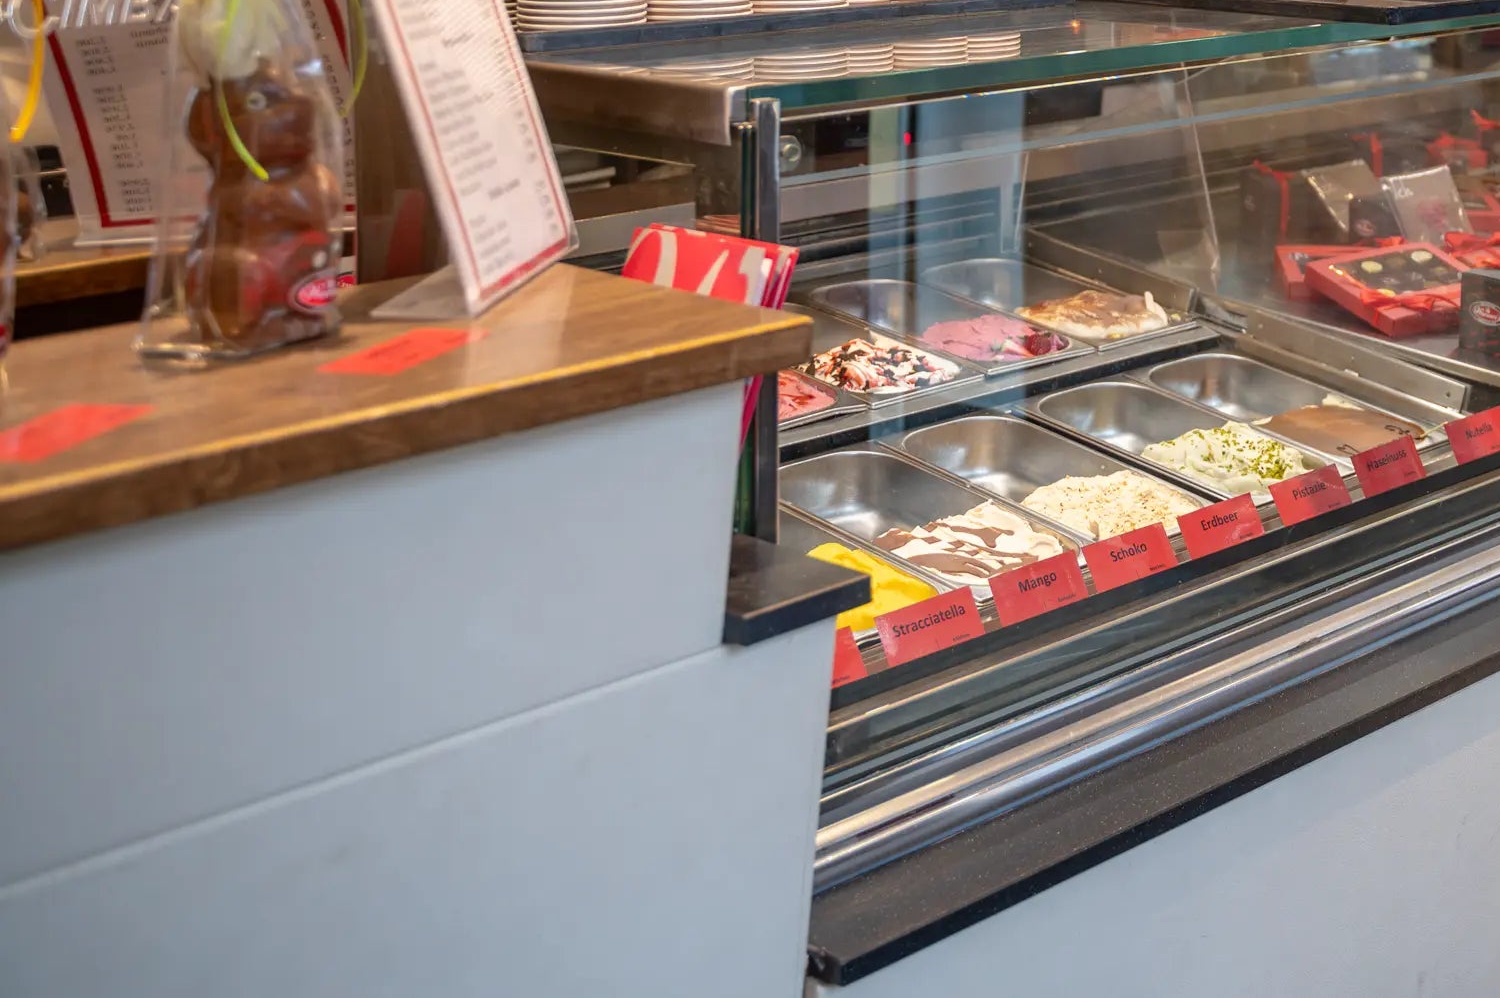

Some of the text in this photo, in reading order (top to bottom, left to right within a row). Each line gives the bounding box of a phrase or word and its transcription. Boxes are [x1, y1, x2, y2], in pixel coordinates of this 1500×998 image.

[1464, 422, 1493, 440] Nutella
[1366, 448, 1407, 472] Haselnuss
[1292, 479, 1328, 501] Pistazie
[1200, 510, 1240, 532] Erdbeer
[1109, 540, 1148, 563] Schoko
[1017, 570, 1058, 594] Mango
[891, 603, 966, 639] Stracciatella
